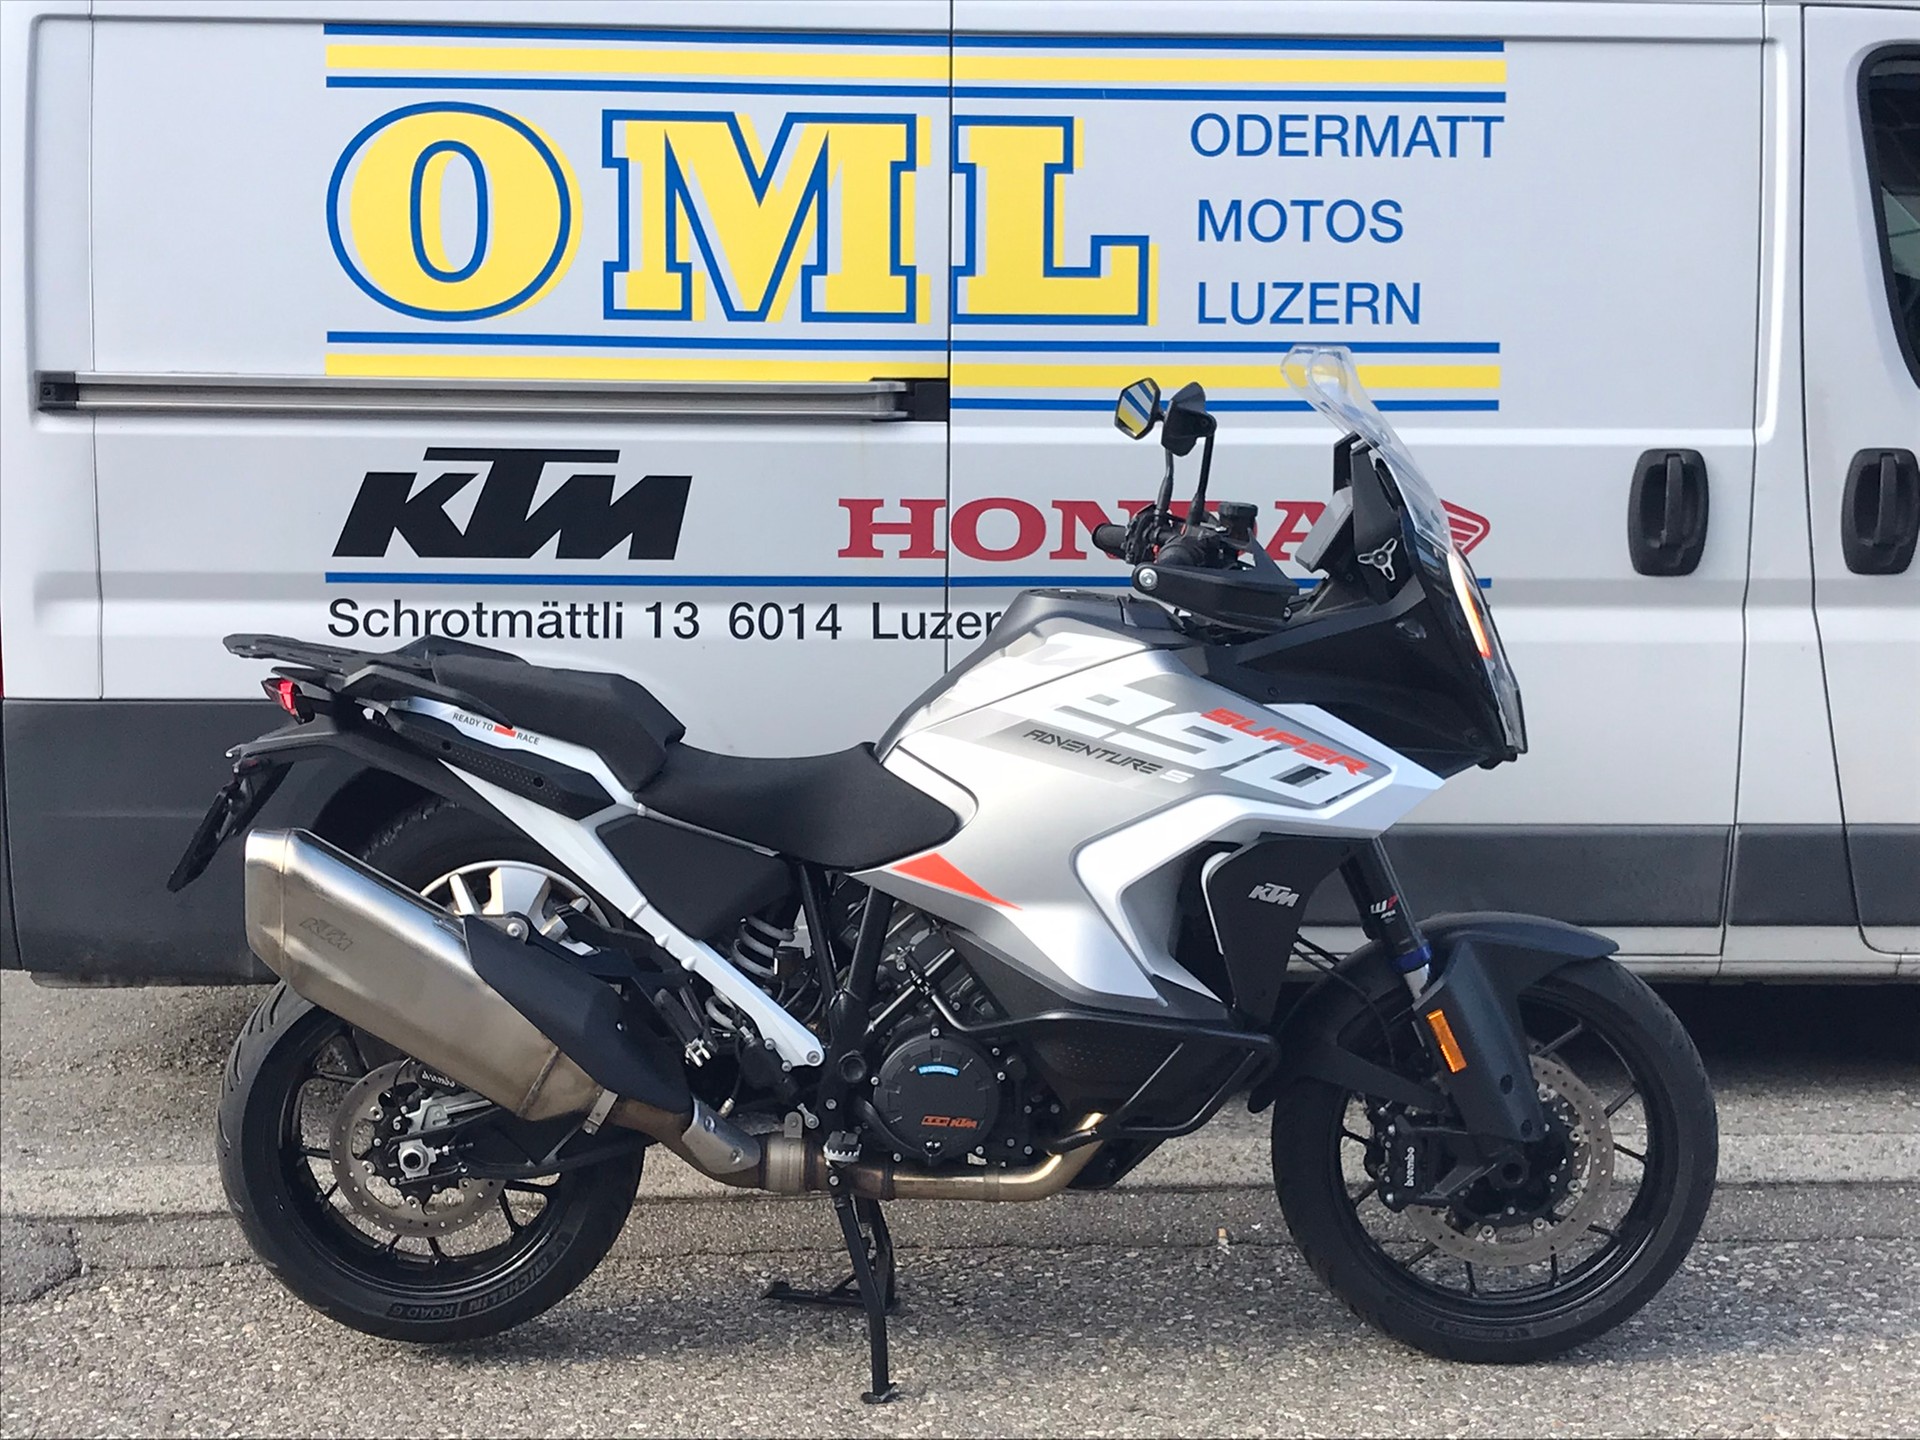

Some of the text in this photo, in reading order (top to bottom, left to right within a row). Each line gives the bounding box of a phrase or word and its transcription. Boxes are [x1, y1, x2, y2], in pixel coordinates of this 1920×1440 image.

[1190, 112, 1505, 158] ODERMATT
[326, 101, 1158, 325] OML
[1198, 198, 1404, 244] MOTOS
[1197, 281, 1421, 325] LUZERN
[333, 447, 692, 560] KTM
[328, 598, 1001, 640] Schrotmättli 13 6014 Luzer
[452, 712, 540, 745] READY TO RACE
[1201, 708, 1368, 776] SUPER
[1023, 729, 1195, 784] ADVENTURE S
[1248, 882, 1300, 908] KTM
[1404, 1146, 1415, 1187] brembo
[469, 1256, 550, 1313] MICHELIN
[408, 1303, 454, 1318] ROAD
